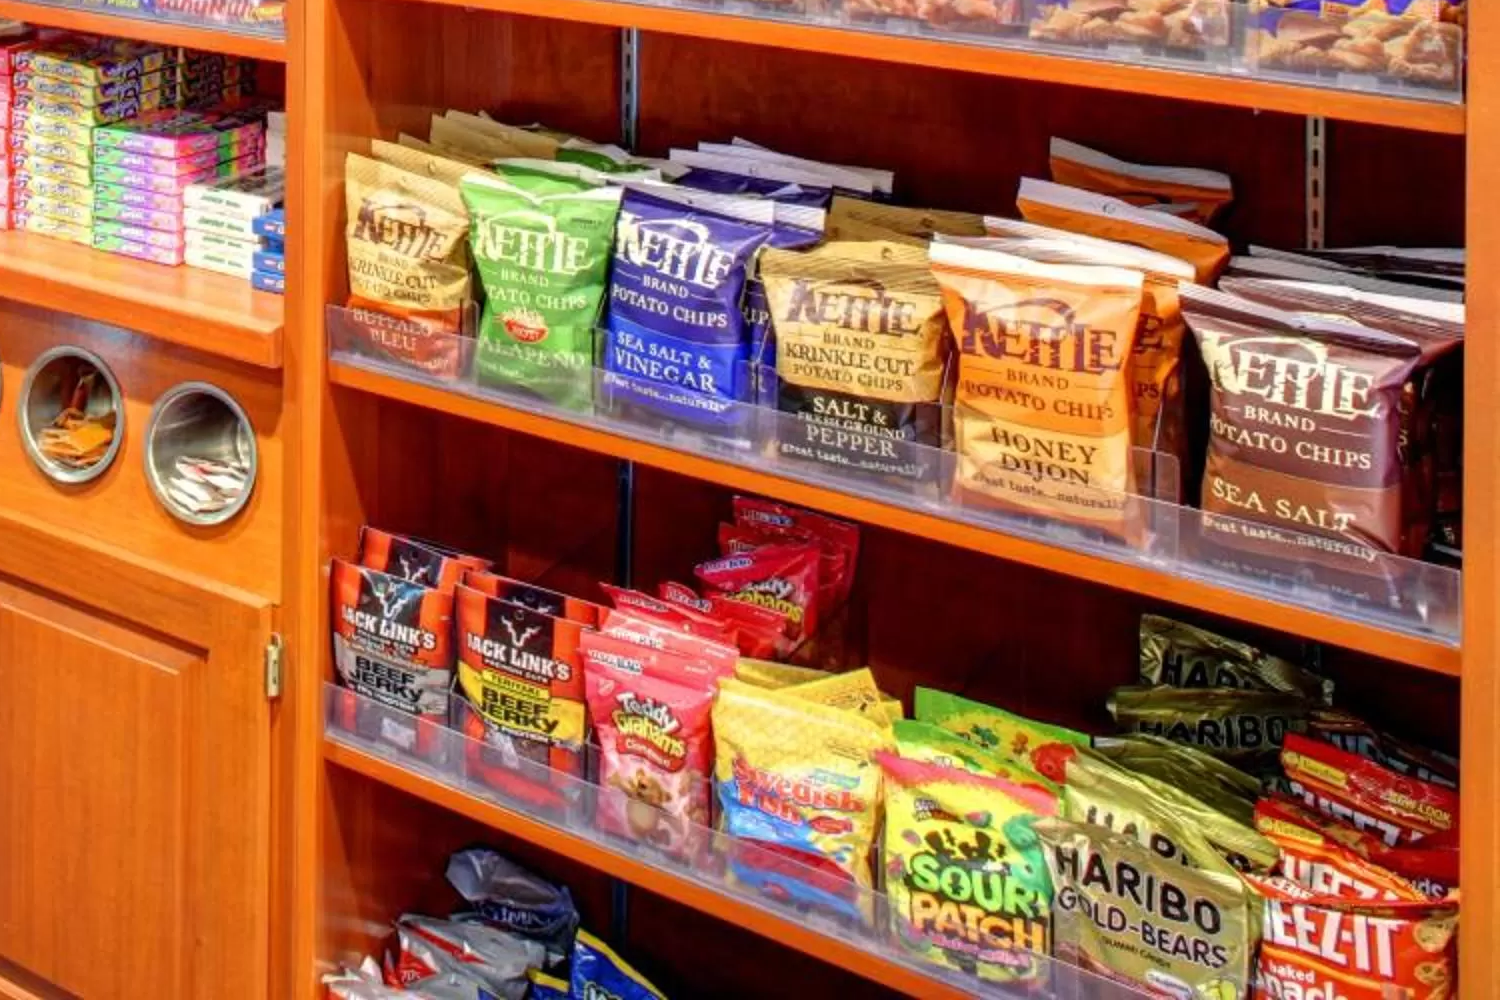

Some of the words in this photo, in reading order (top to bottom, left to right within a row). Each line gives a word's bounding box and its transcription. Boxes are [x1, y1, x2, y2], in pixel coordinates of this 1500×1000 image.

[353, 198, 449, 264] KETTLE
[474, 210, 595, 276] KETTLE
[615, 210, 736, 290] KETTLE
[405, 274, 438, 290] CUT
[500, 268, 549, 287] BRAND
[643, 275, 689, 300] BRAND
[535, 294, 587, 311] CHIPS
[611, 283, 669, 316] POTATO
[672, 305, 729, 329] CHIPS
[784, 277, 922, 338] KETTLE
[371, 327, 417, 351] BLEU
[616, 331, 645, 354] SEA
[649, 341, 693, 366] SALT
[698, 354, 713, 370] &
[822, 330, 876, 350] BRAND
[961, 297, 1124, 376] KETTLE
[613, 346, 717, 394] VINEGAR
[784, 341, 872, 370] KRINKLE
[873, 355, 916, 377] CUT
[1199, 327, 1382, 420] KETTLE
[792, 363, 854, 382] POTATO
[857, 373, 904, 392] CHIPS
[963, 378, 1046, 412] POTATO
[1006, 367, 1070, 391] BRAND
[813, 396, 870, 422] SALT
[873, 408, 889, 426] &
[1243, 404, 1316, 433] BRAND
[806, 423, 900, 459] PEPPER
[842, 418, 906, 441] GROUND
[991, 425, 1098, 466] HONEY
[1000, 452, 1090, 485] DIJON
[1294, 440, 1373, 470] CHIPS
[1210, 476, 1267, 515] SEA
[1274, 498, 1357, 532] SALT
[341, 604, 376, 632] JACK
[379, 618, 437, 650] LINK'S
[355, 655, 416, 684] BEEF
[467, 632, 506, 661] JACK
[510, 648, 572, 681] LINK'S
[350, 670, 425, 704] JERKY
[481, 686, 550, 716] BEEF
[483, 703, 560, 735] JERKY
[615, 691, 680, 734] Teddy
[613, 711, 687, 759] Grahams
[1138, 714, 1290, 749] HARIBO
[733, 752, 867, 813] Swedish
[739, 782, 807, 827] Fish
[910, 852, 1042, 919] SOUR
[1055, 845, 1222, 935] HARIBO
[910, 891, 1049, 955] PATCH
[1057, 885, 1229, 969] GOLD-BEARS
[1268, 958, 1316, 985] baked
